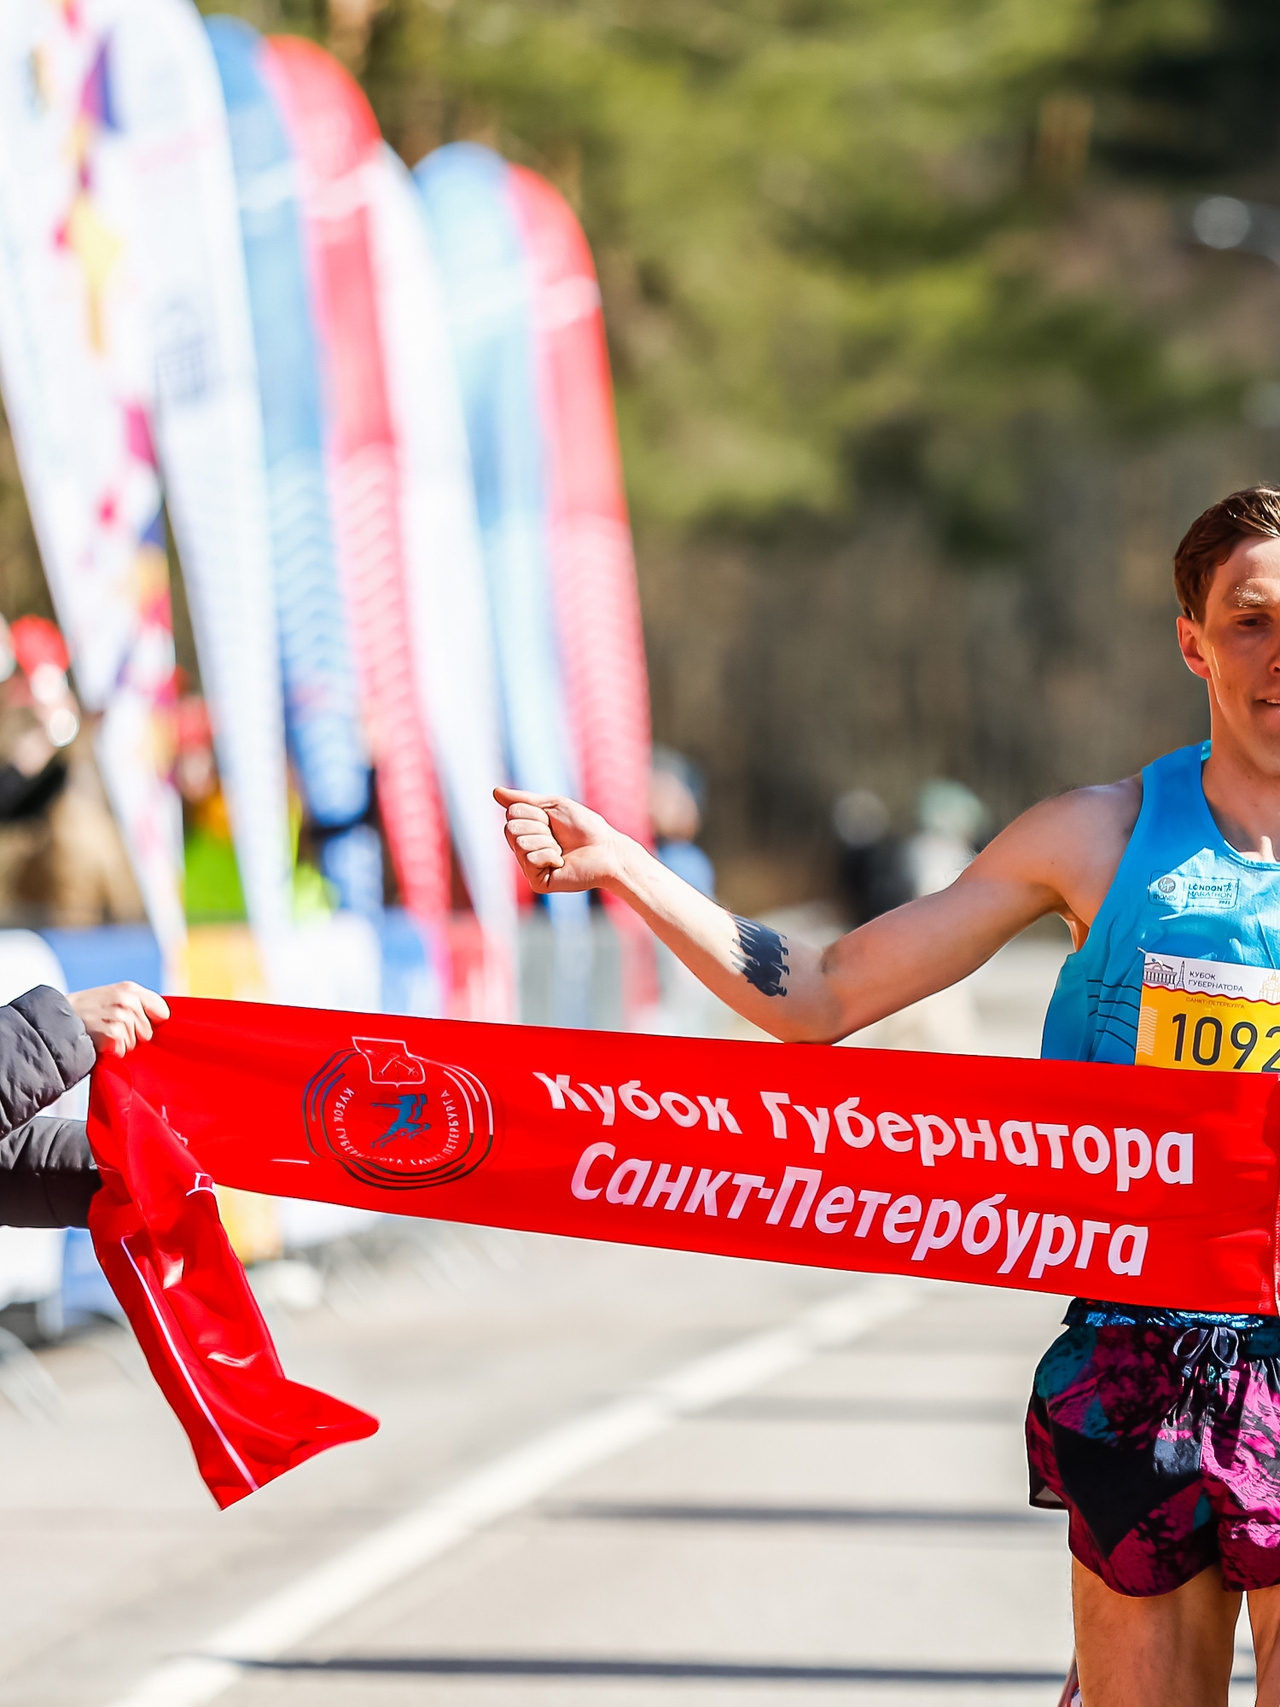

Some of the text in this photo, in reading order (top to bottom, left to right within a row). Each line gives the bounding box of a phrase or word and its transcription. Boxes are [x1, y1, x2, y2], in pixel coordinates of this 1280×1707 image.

[1188, 883, 1223, 891] LONDON
[1189, 971, 1216, 981] КУБОК
[1188, 979, 1244, 992] ГУБЕРНАТОРА
[532, 1071, 1195, 1193] Кубок Губернатора
[571, 1141, 1149, 1279] Санкт-Петербурга
